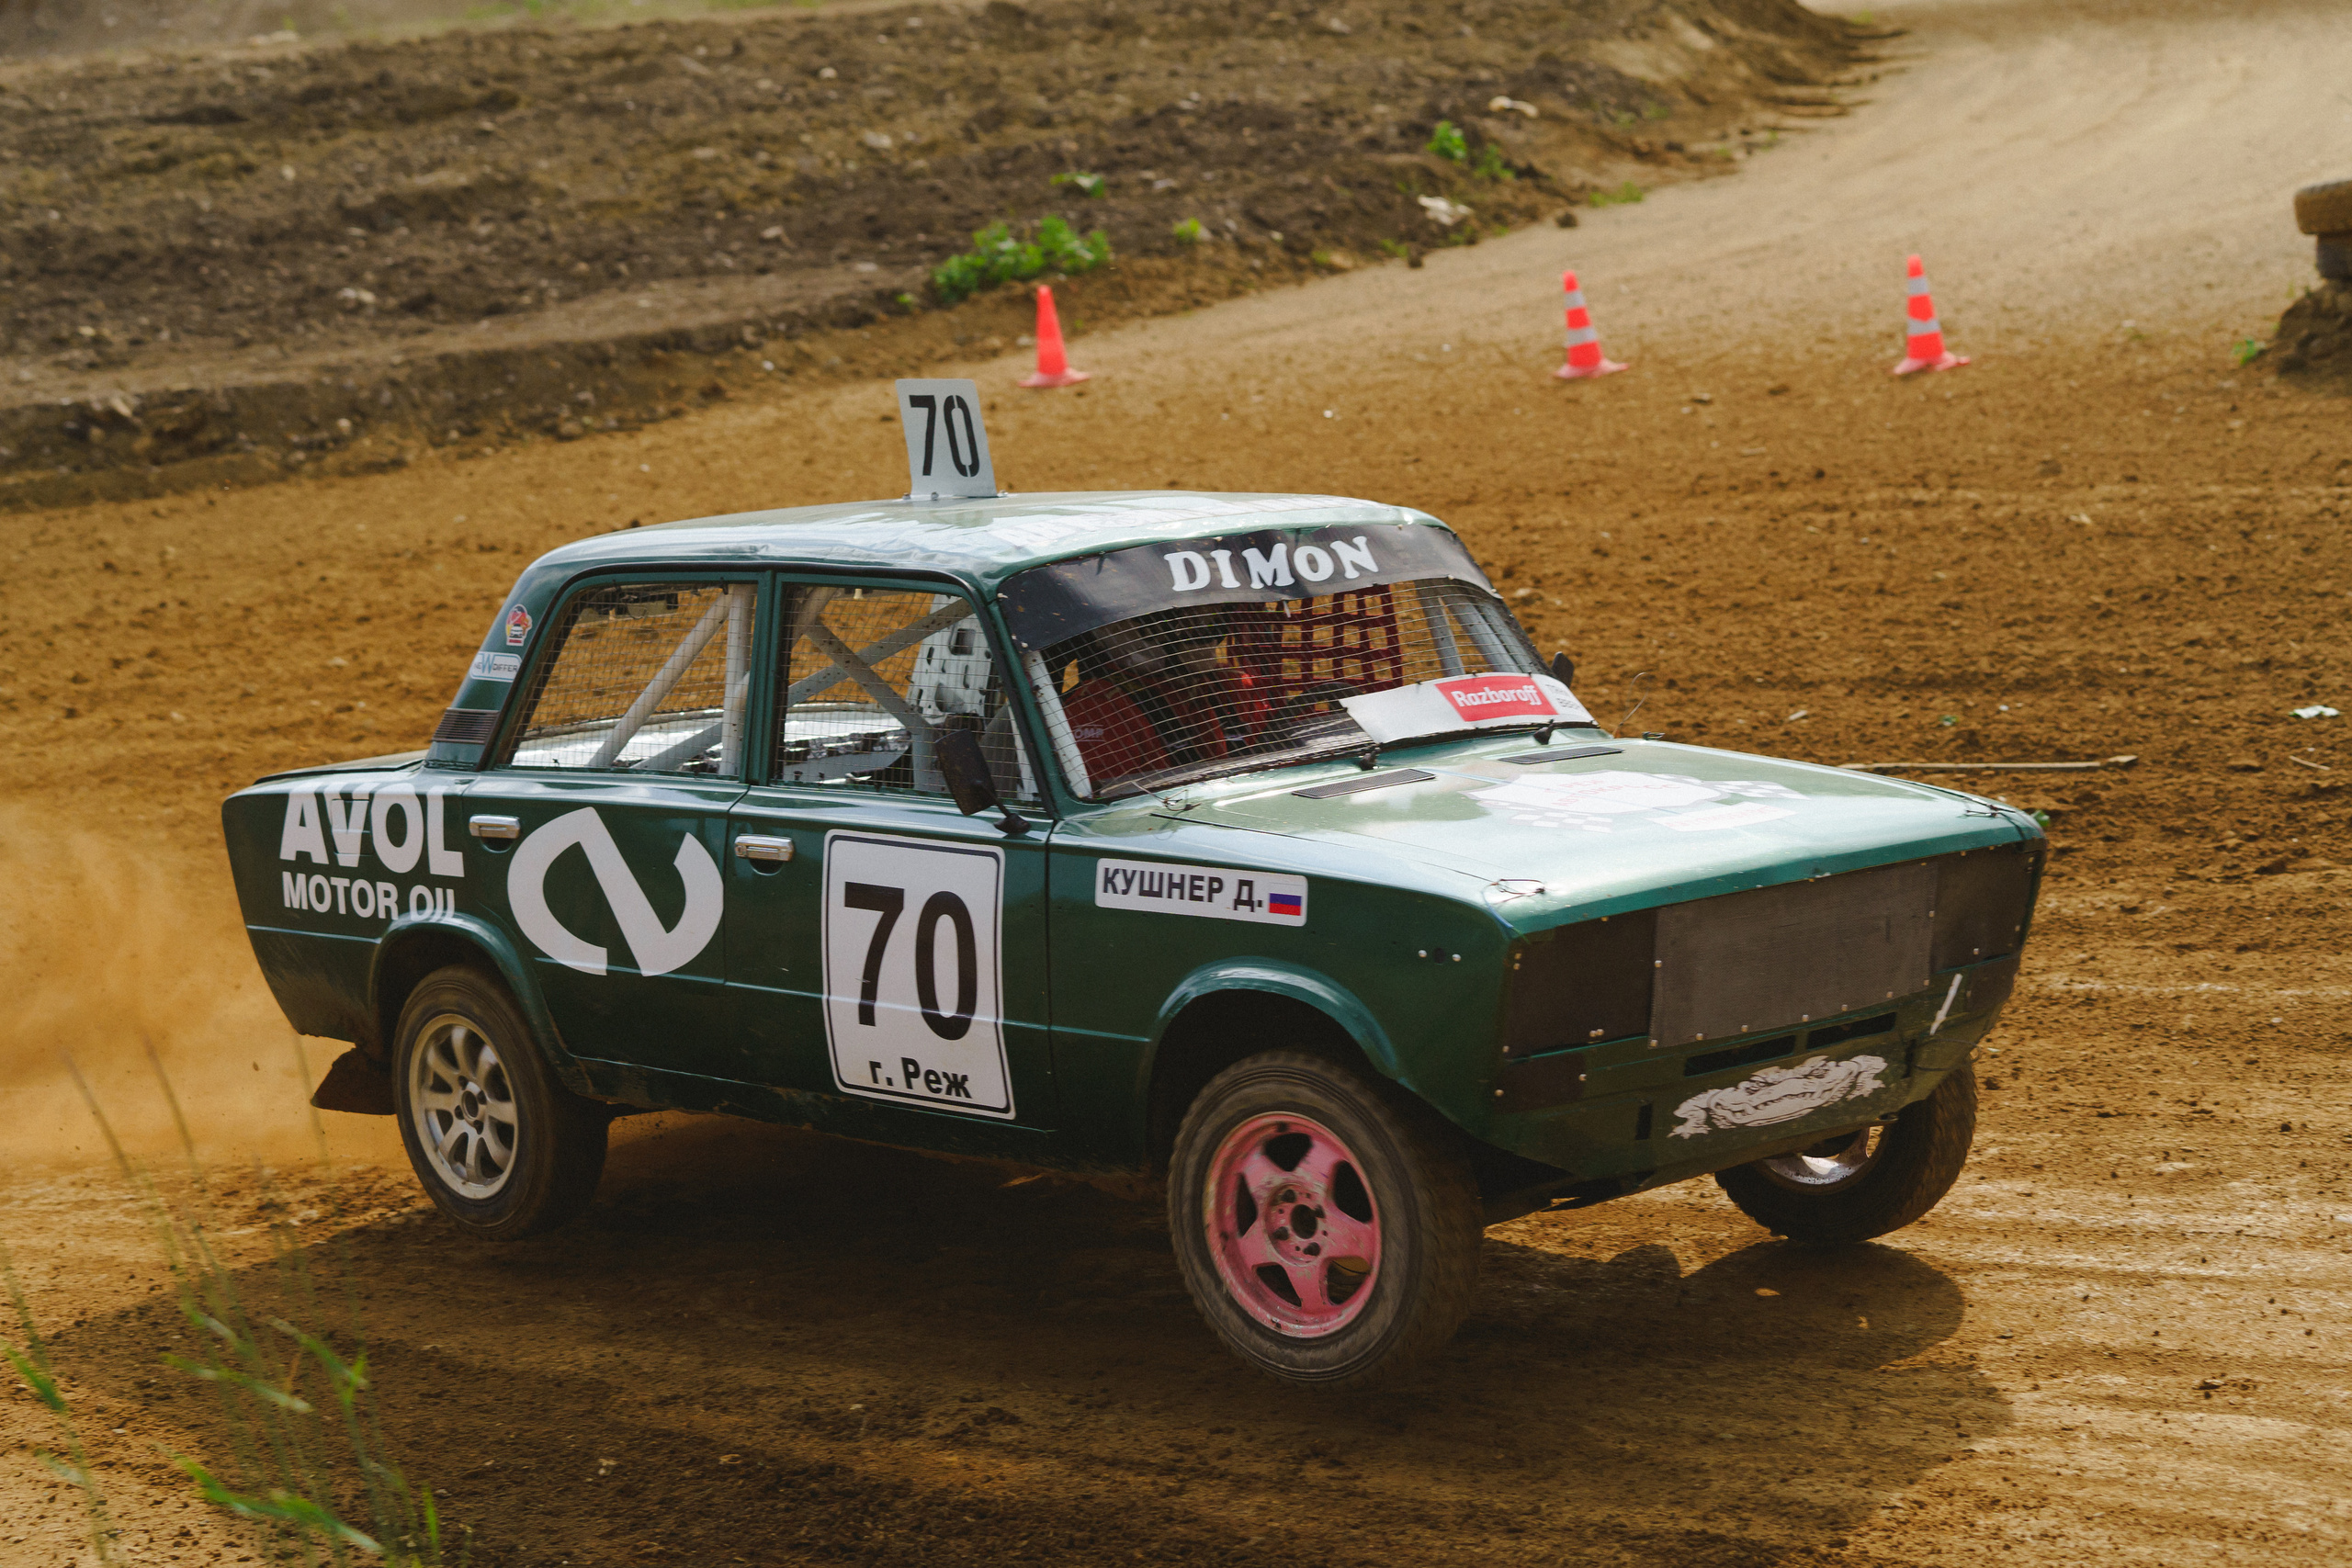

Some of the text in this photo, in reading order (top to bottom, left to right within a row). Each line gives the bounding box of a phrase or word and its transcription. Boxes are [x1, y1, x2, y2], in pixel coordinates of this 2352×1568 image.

[910, 395, 980, 477] 70
[1164, 536, 1378, 592] DIMON
[1451, 684, 1543, 706] Razboroff
[279, 782, 465, 878] AVOL
[282, 871, 457, 923] MOTOR OIL
[1102, 867, 1263, 912] КУШНЕР Д.
[843, 881, 978, 1041] 70
[869, 1057, 972, 1099] г. Реж
